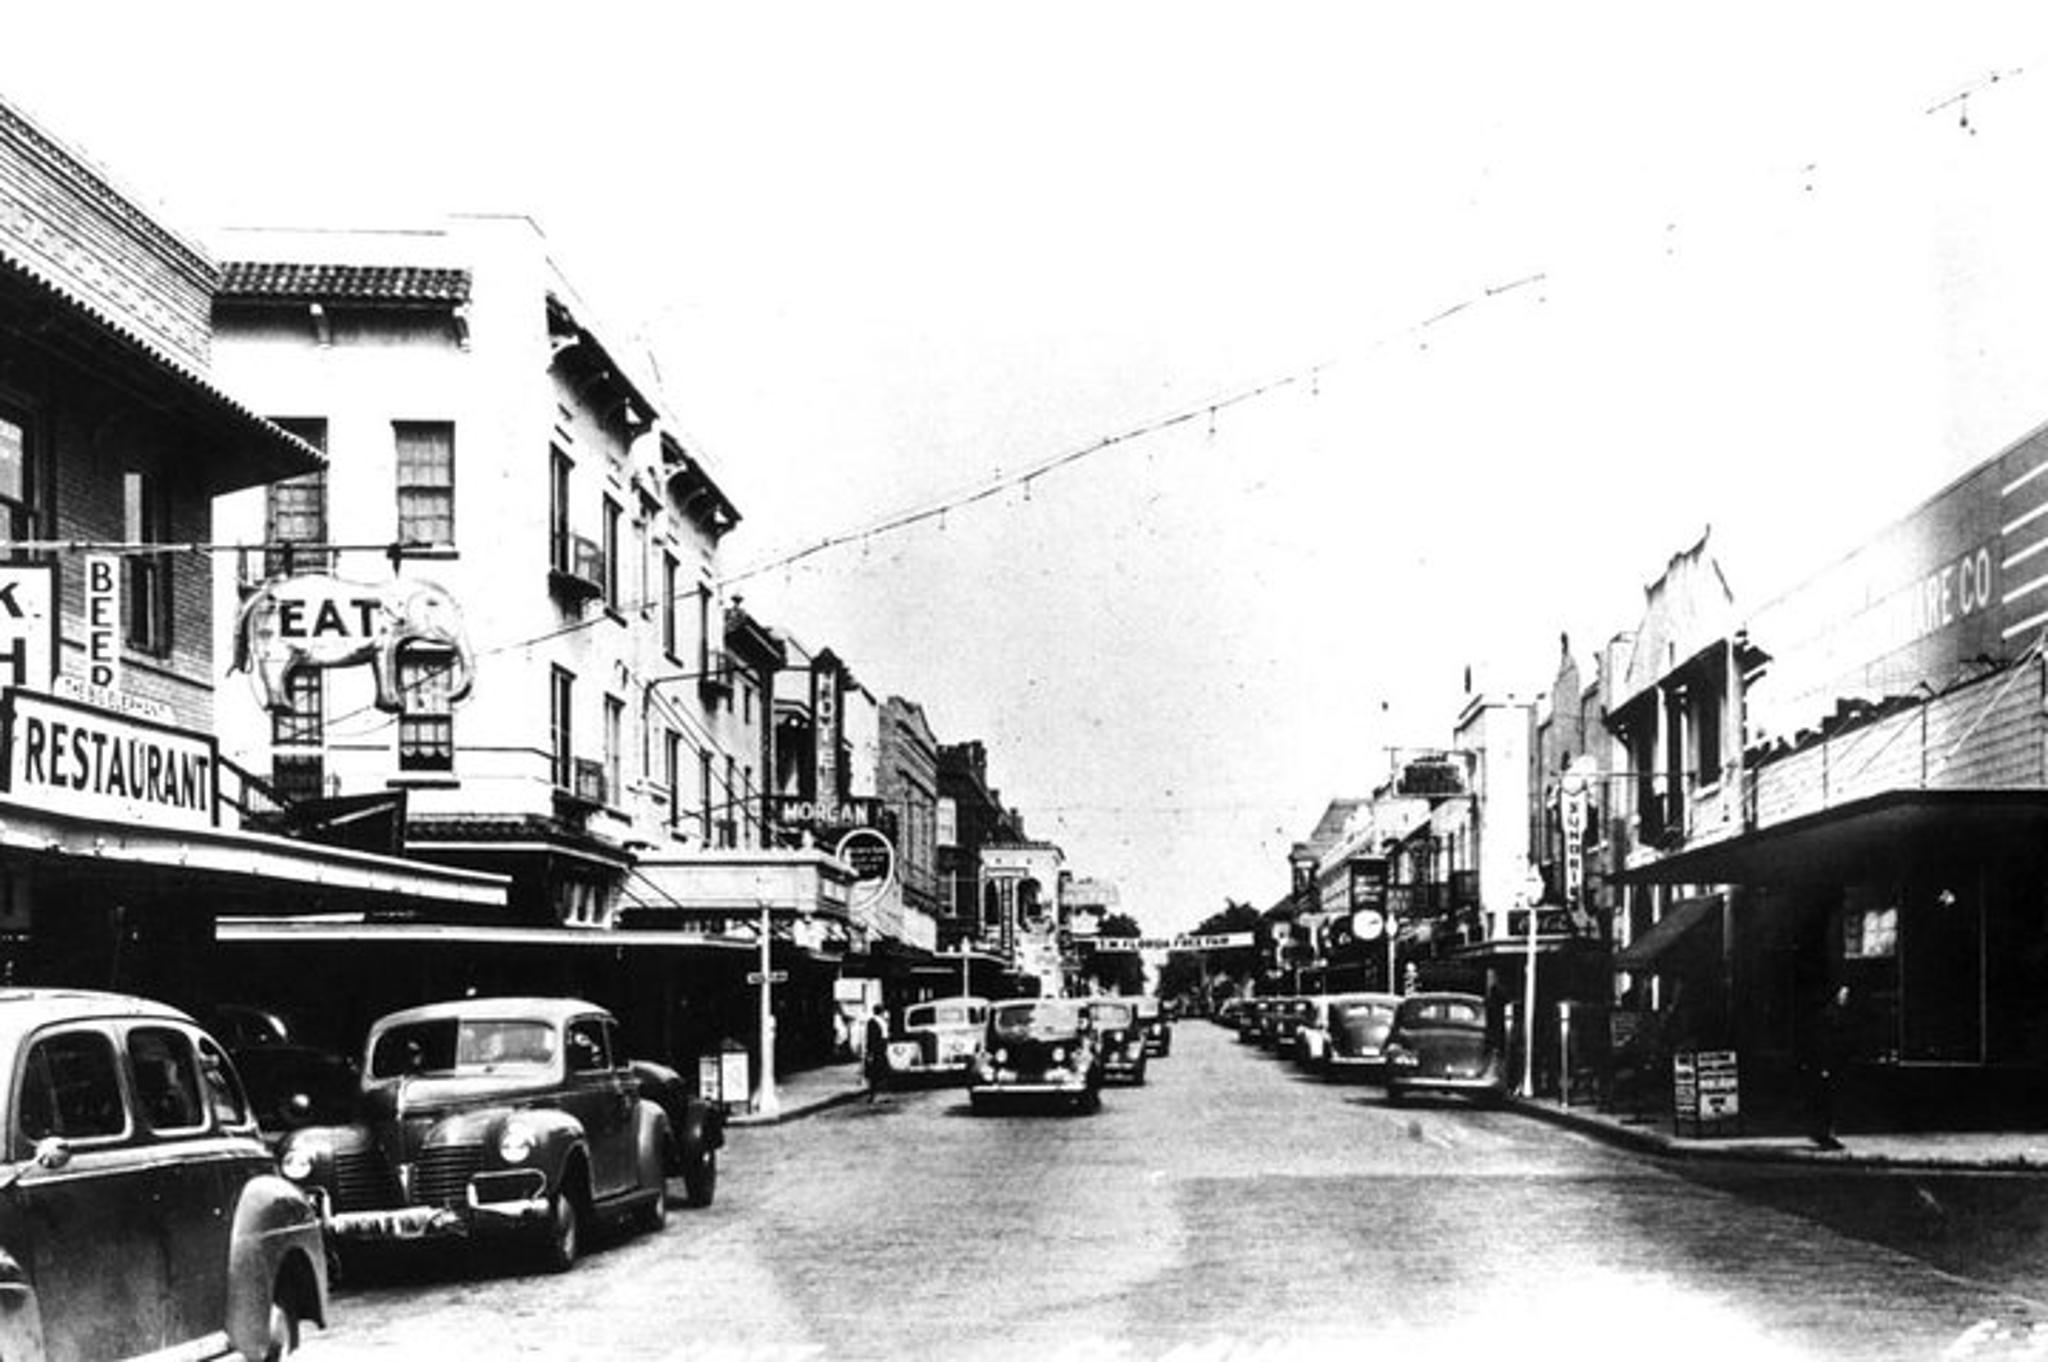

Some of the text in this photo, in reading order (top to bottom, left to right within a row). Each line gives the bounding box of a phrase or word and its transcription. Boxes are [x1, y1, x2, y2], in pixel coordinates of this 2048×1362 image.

[1959, 547, 1990, 615] CO
[25, 716, 208, 812] RESTAURANT
[783, 801, 868, 827] MORGAN
